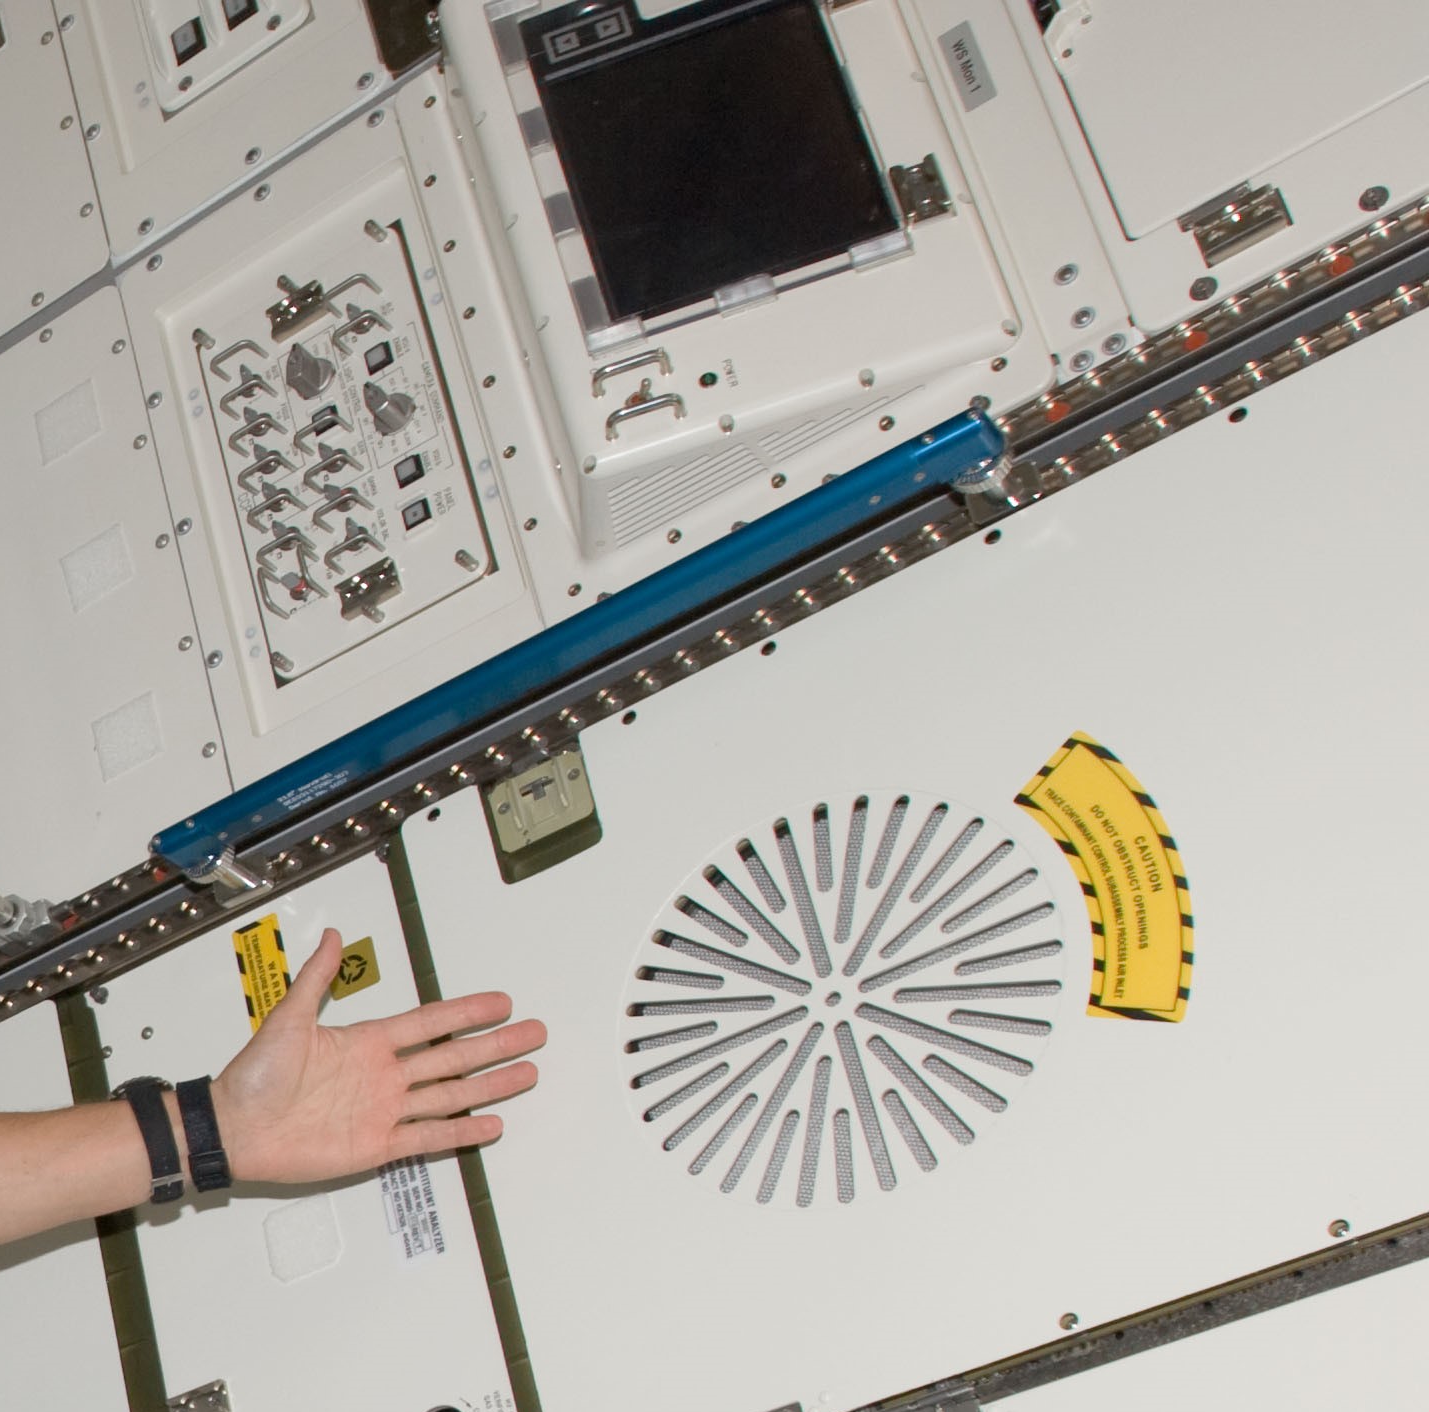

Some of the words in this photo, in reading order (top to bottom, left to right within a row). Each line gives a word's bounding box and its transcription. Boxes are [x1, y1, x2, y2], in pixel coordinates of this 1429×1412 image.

[951, 38, 968, 60] WS
[959, 58, 975, 85] Mon
[969, 84, 981, 93] 1
[1044, 787, 1065, 808] TRACE
[1061, 804, 1096, 851] CONTAMINANT
[1090, 844, 1110, 876] CONTROL
[1133, 835, 1162, 892] CAUTION
[1089, 804, 1104, 819] DO
[1100, 818, 1118, 838] NOT
[1112, 839, 1140, 891] OBSTRUCT
[1132, 894, 1148, 949] OPENINGS
[1104, 875, 1124, 925] SUBASSEMBLY
[1116, 926, 1127, 962] PROCESS
[251, 933, 268, 990] TEMPERATURE
[263, 991, 271, 1007] MAY
[1116, 963, 1126, 978] AIR
[1113, 976, 1125, 998] INLET
[425, 1210, 444, 1254] ANALYZER
[483, 1394, 492, 1409] GAS
